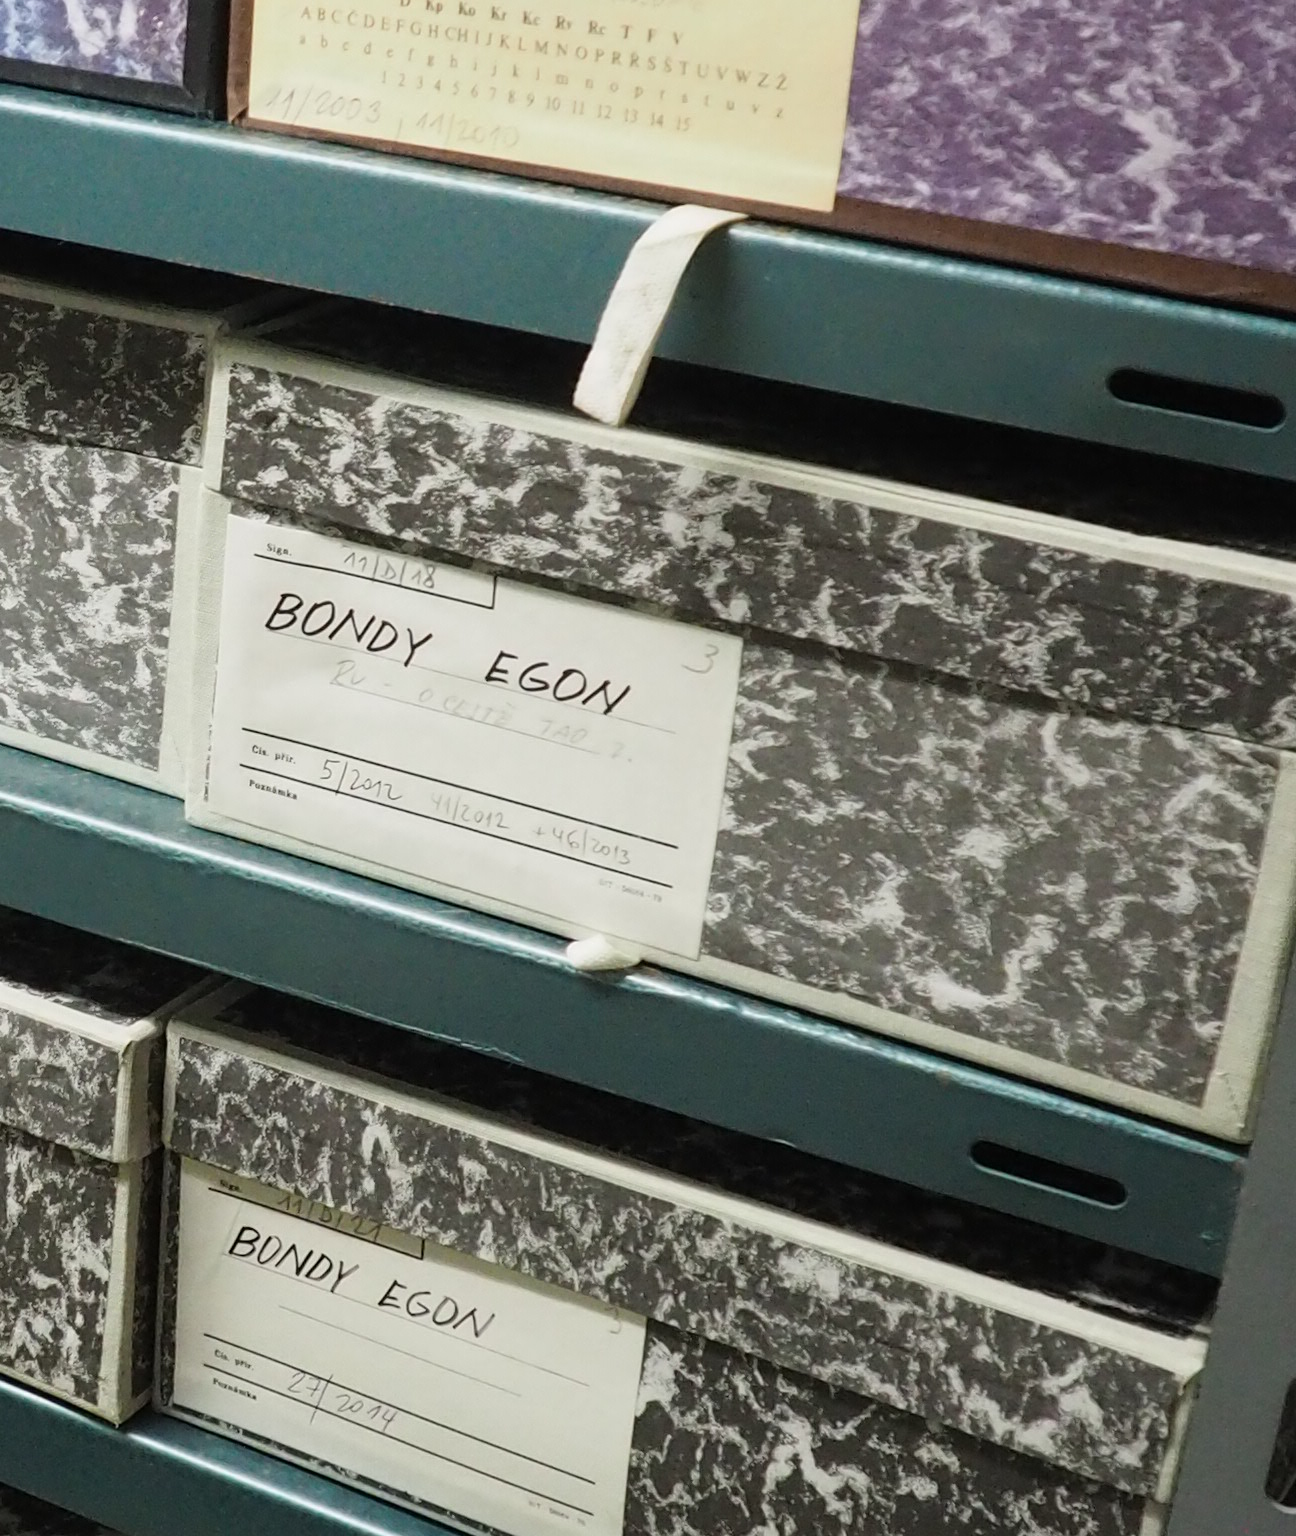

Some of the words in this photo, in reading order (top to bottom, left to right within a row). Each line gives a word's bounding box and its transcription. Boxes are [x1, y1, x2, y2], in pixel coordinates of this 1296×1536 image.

[265, 592, 433, 668] BONDY
[484, 649, 631, 716] EGON
[321, 758, 403, 802] 5/2012
[228, 1225, 360, 1293] BONDY
[378, 1279, 496, 1340] EGON
